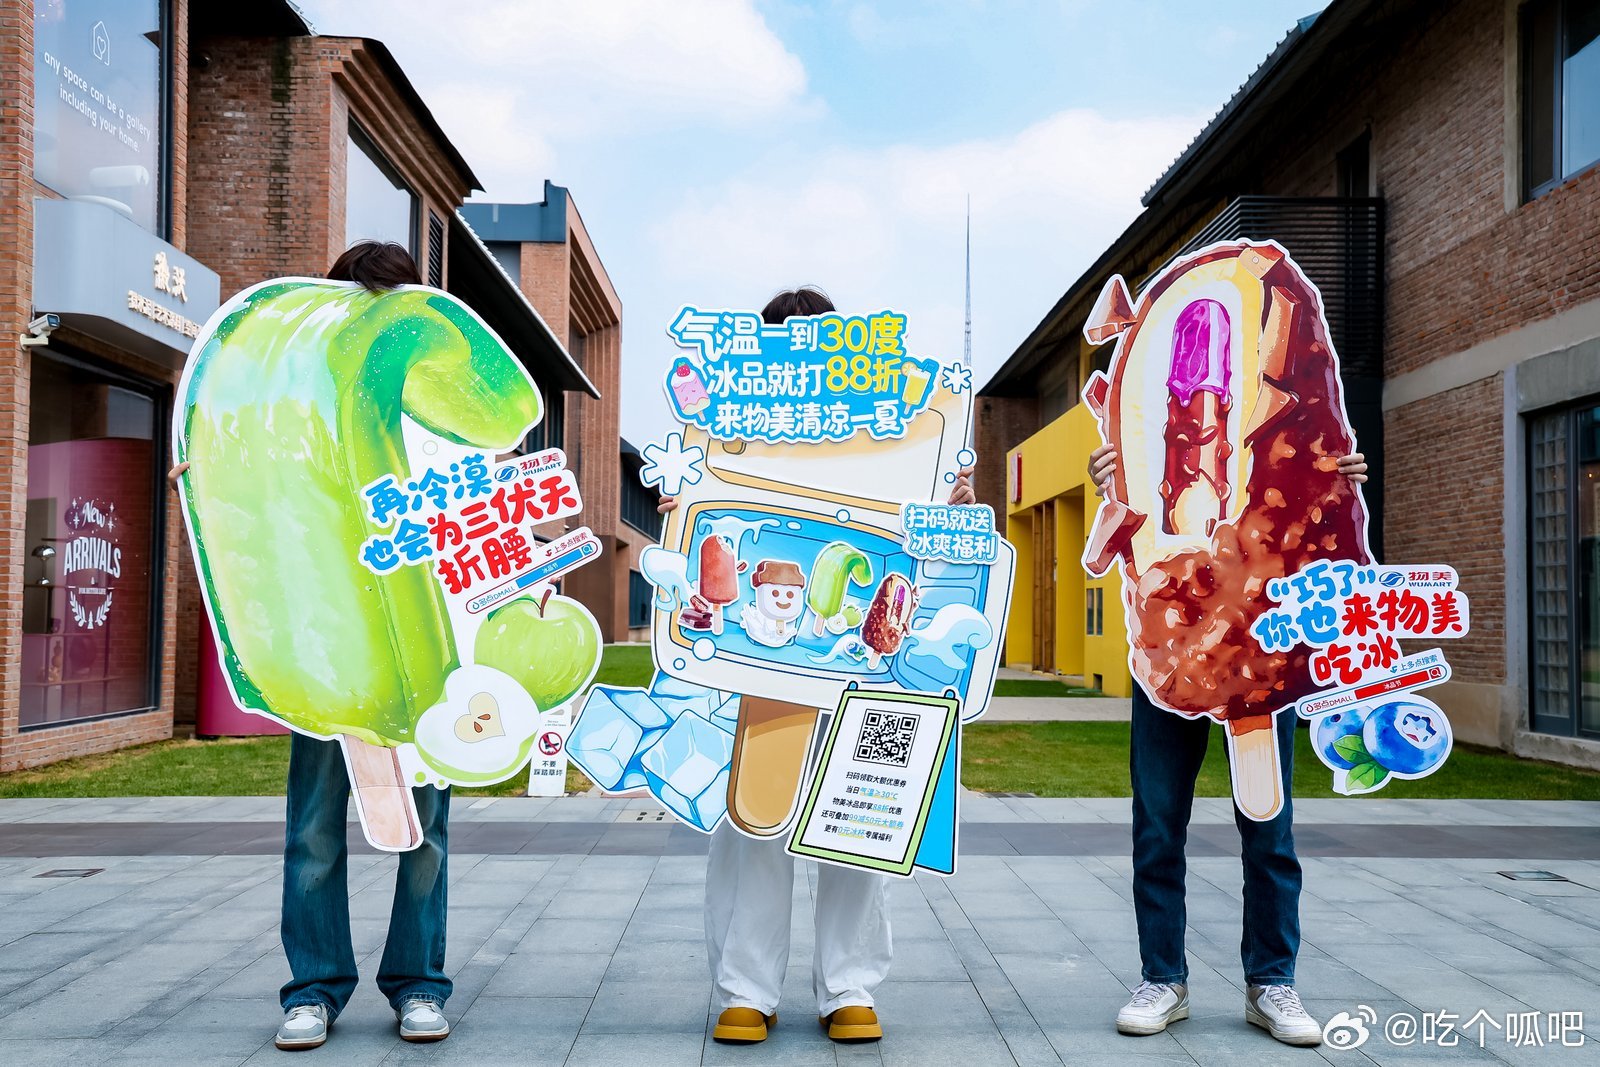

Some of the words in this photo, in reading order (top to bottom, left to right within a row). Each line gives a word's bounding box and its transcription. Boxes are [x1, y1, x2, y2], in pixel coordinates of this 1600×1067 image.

[44, 52, 60, 75] any
[63, 66, 88, 92] space
[90, 86, 104, 105] can
[107, 96, 116, 114] be
[119, 108, 123, 119] a
[126, 114, 151, 142] gallery
[60, 84, 97, 127] including
[100, 115, 116, 136] your
[119, 126, 140, 152] home.
[674, 311, 904, 362] 气温一到30度
[706, 355, 900, 397] 冰品就打88折
[715, 400, 900, 435] 来物美清凉一夏
[366, 453, 493, 524] 再冷漠
[522, 462, 561, 476] WUMART
[82, 500, 106, 528] New
[906, 505, 990, 534] 扫码就送
[64, 536, 122, 578] ARRIVALS
[438, 527, 532, 594] 折腰
[910, 530, 996, 559] 冰爽福利
[1314, 633, 1399, 685] 吃冰
[1400, 654, 1438, 672] 上多点搜索
[846, 771, 907, 787] 扫码领取大额优惠券
